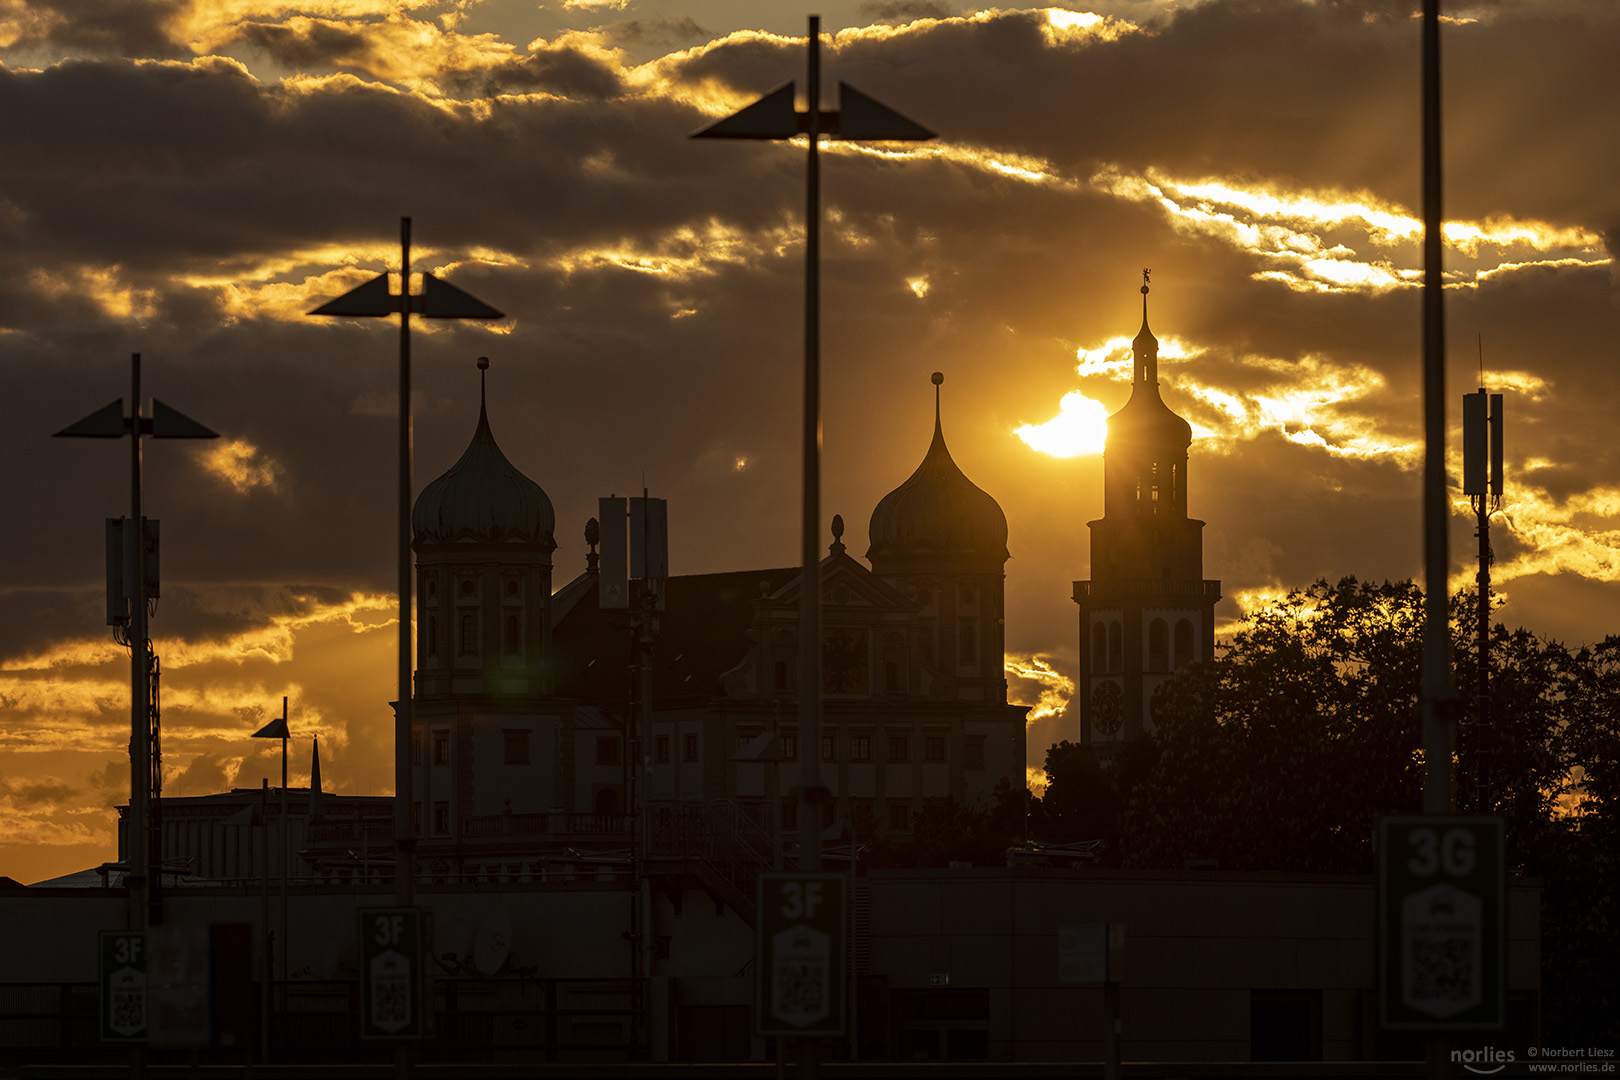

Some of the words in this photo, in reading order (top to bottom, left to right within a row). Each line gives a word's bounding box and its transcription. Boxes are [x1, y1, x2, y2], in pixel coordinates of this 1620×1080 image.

[1408, 827, 1477, 877] 3G
[781, 881, 823, 919] 3F
[375, 915, 403, 945] 3F
[115, 938, 142, 963] 3F
